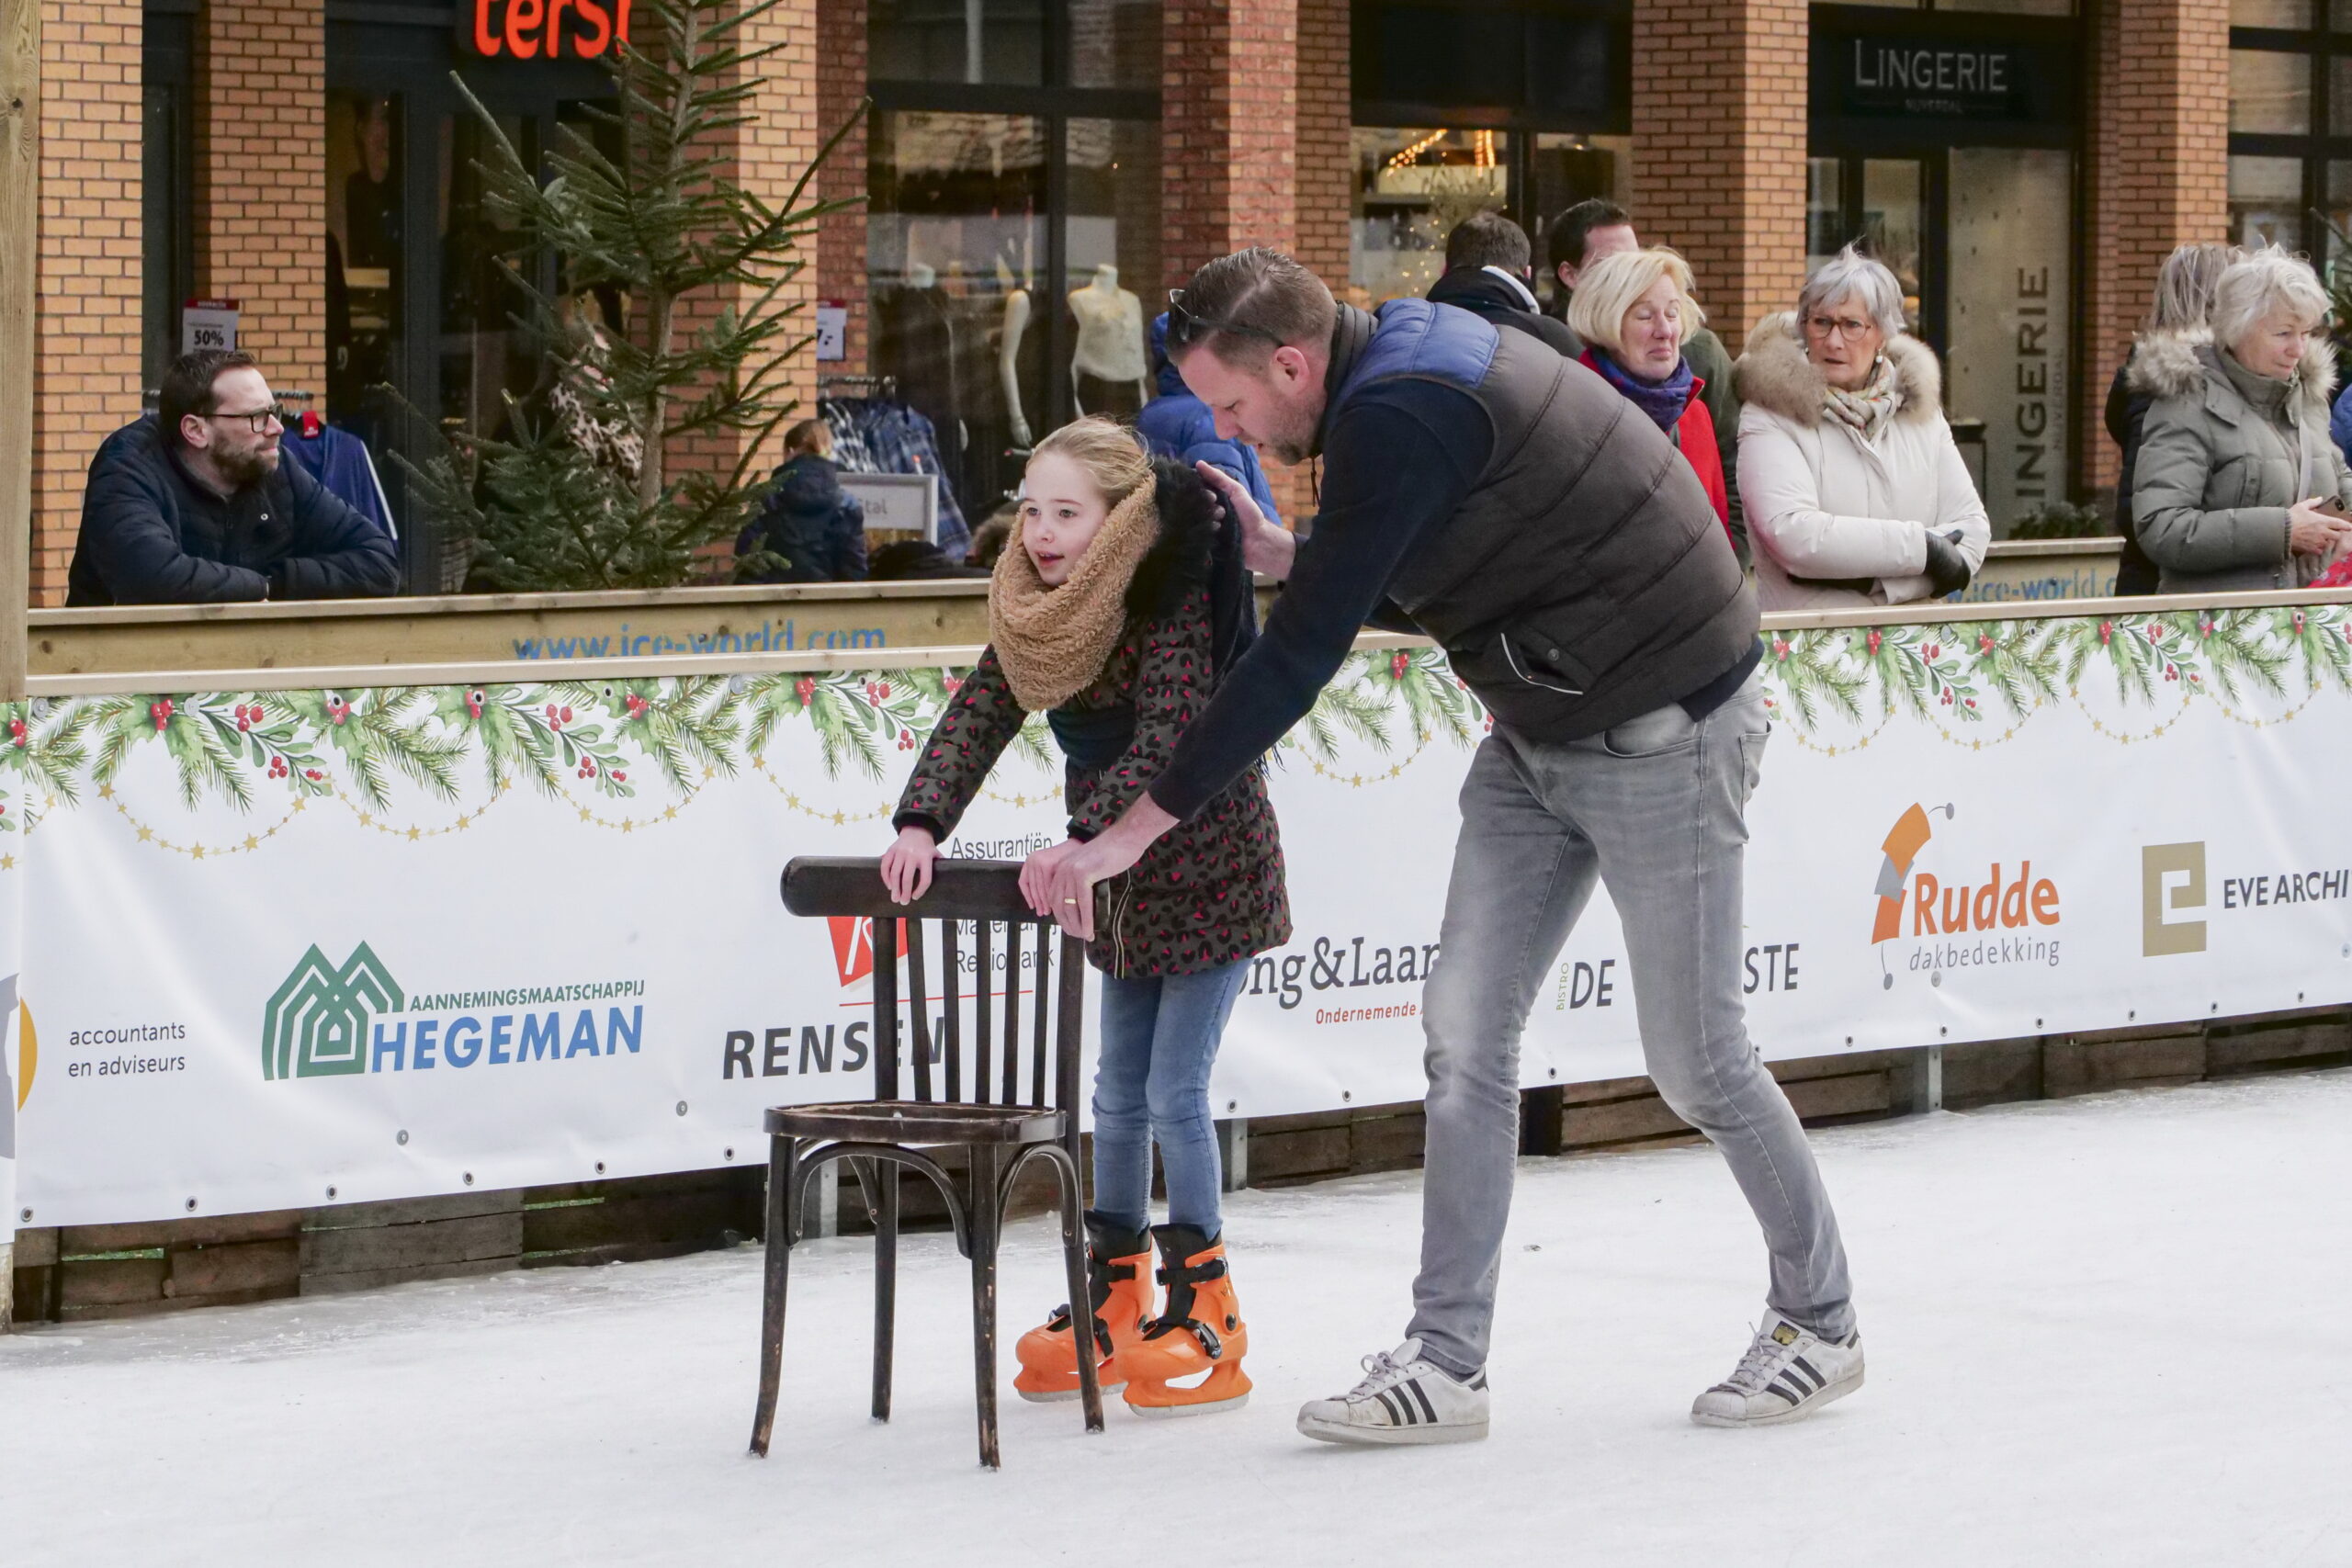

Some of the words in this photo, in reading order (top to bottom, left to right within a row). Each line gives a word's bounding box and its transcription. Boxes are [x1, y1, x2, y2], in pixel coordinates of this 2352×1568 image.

[1855, 39, 2007, 91] LINGERIE
[194, 330, 225, 346] 50%
[2016, 265, 2049, 502] INGERIE
[512, 619, 886, 660] www.ice-world.com
[1914, 860, 2060, 937] Rudde
[2223, 875, 2269, 909] EVE
[2273, 868, 2352, 905] ARCHI
[1909, 936, 2060, 972] dakbedekking
[410, 979, 645, 1011] AANNEMINGSMAATSCHAPPIJ
[1555, 962, 1569, 1010] BISTRO
[1569, 959, 1615, 1009] DE
[1316, 1001, 1417, 1024] Ondernemende
[69, 1022, 186, 1045] accountants
[371, 1005, 643, 1073] HEGEMAN
[68, 1061, 92, 1077] en
[98, 1055, 186, 1076] adviseurs
